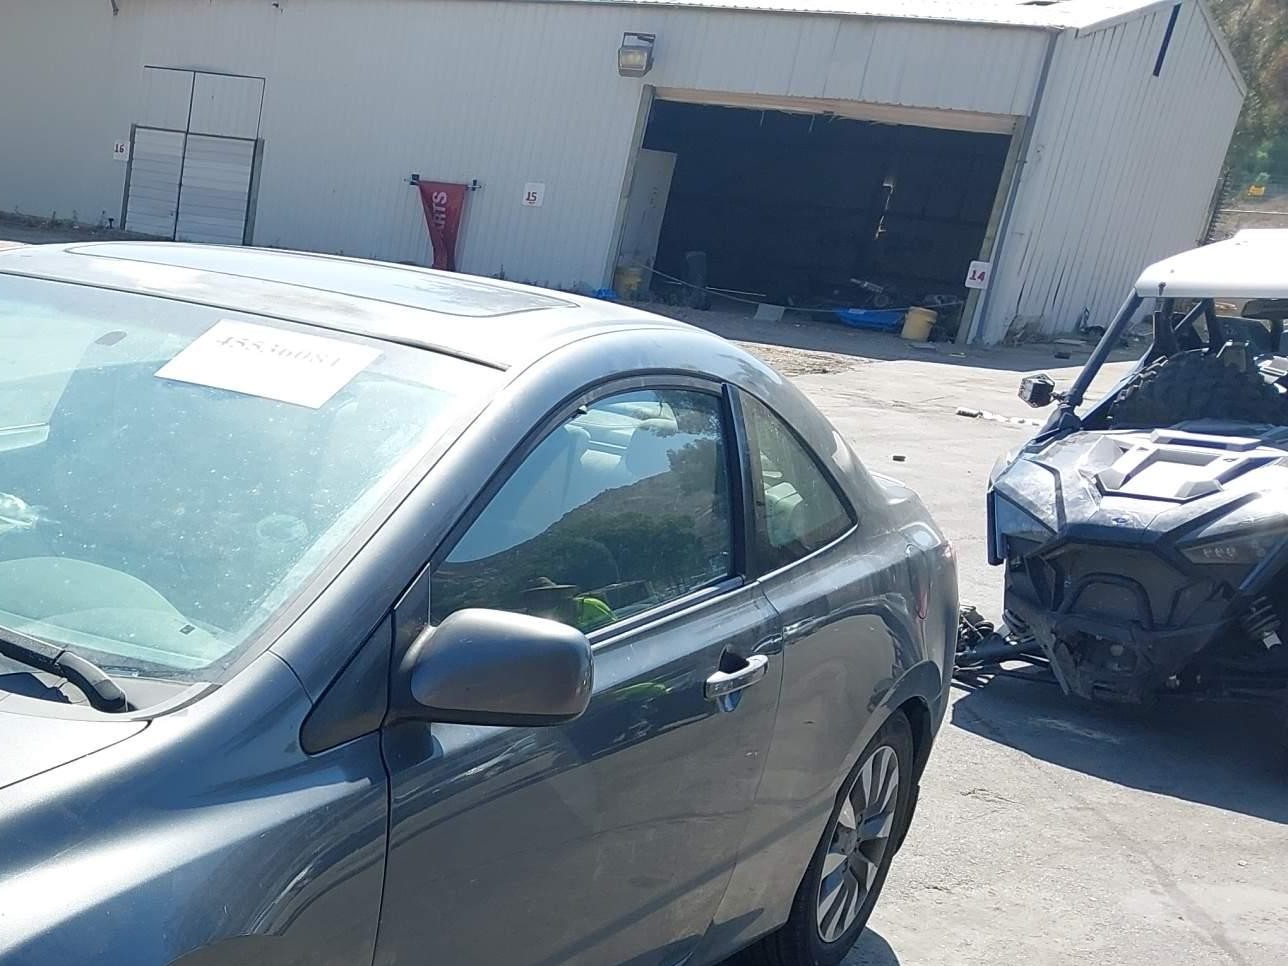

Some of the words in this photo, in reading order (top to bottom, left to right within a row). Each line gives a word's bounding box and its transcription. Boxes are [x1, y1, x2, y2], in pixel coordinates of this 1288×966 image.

[114, 143, 125, 153] 16
[525, 191, 537, 202] 15
[969, 270, 986, 282] 14
